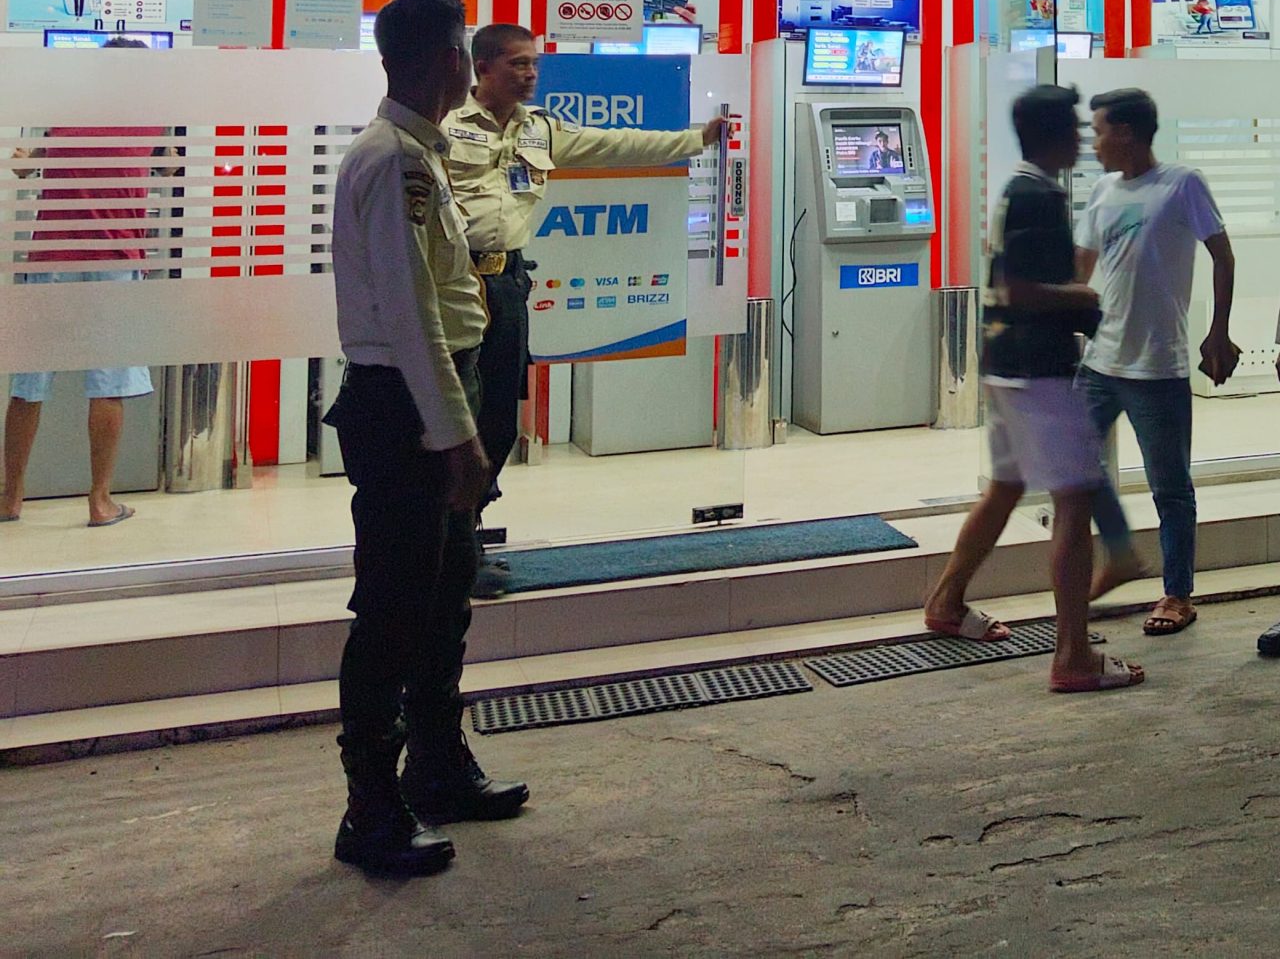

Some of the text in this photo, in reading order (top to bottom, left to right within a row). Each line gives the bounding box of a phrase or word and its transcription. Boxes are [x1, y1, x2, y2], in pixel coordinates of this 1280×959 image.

[586, 95, 643, 125] BRI
[735, 161, 743, 205] DORONG
[535, 203, 648, 237] ATM
[595, 277, 619, 287] VISA
[875, 267, 901, 283] BRI
[627, 293, 669, 304] BRIZZI
